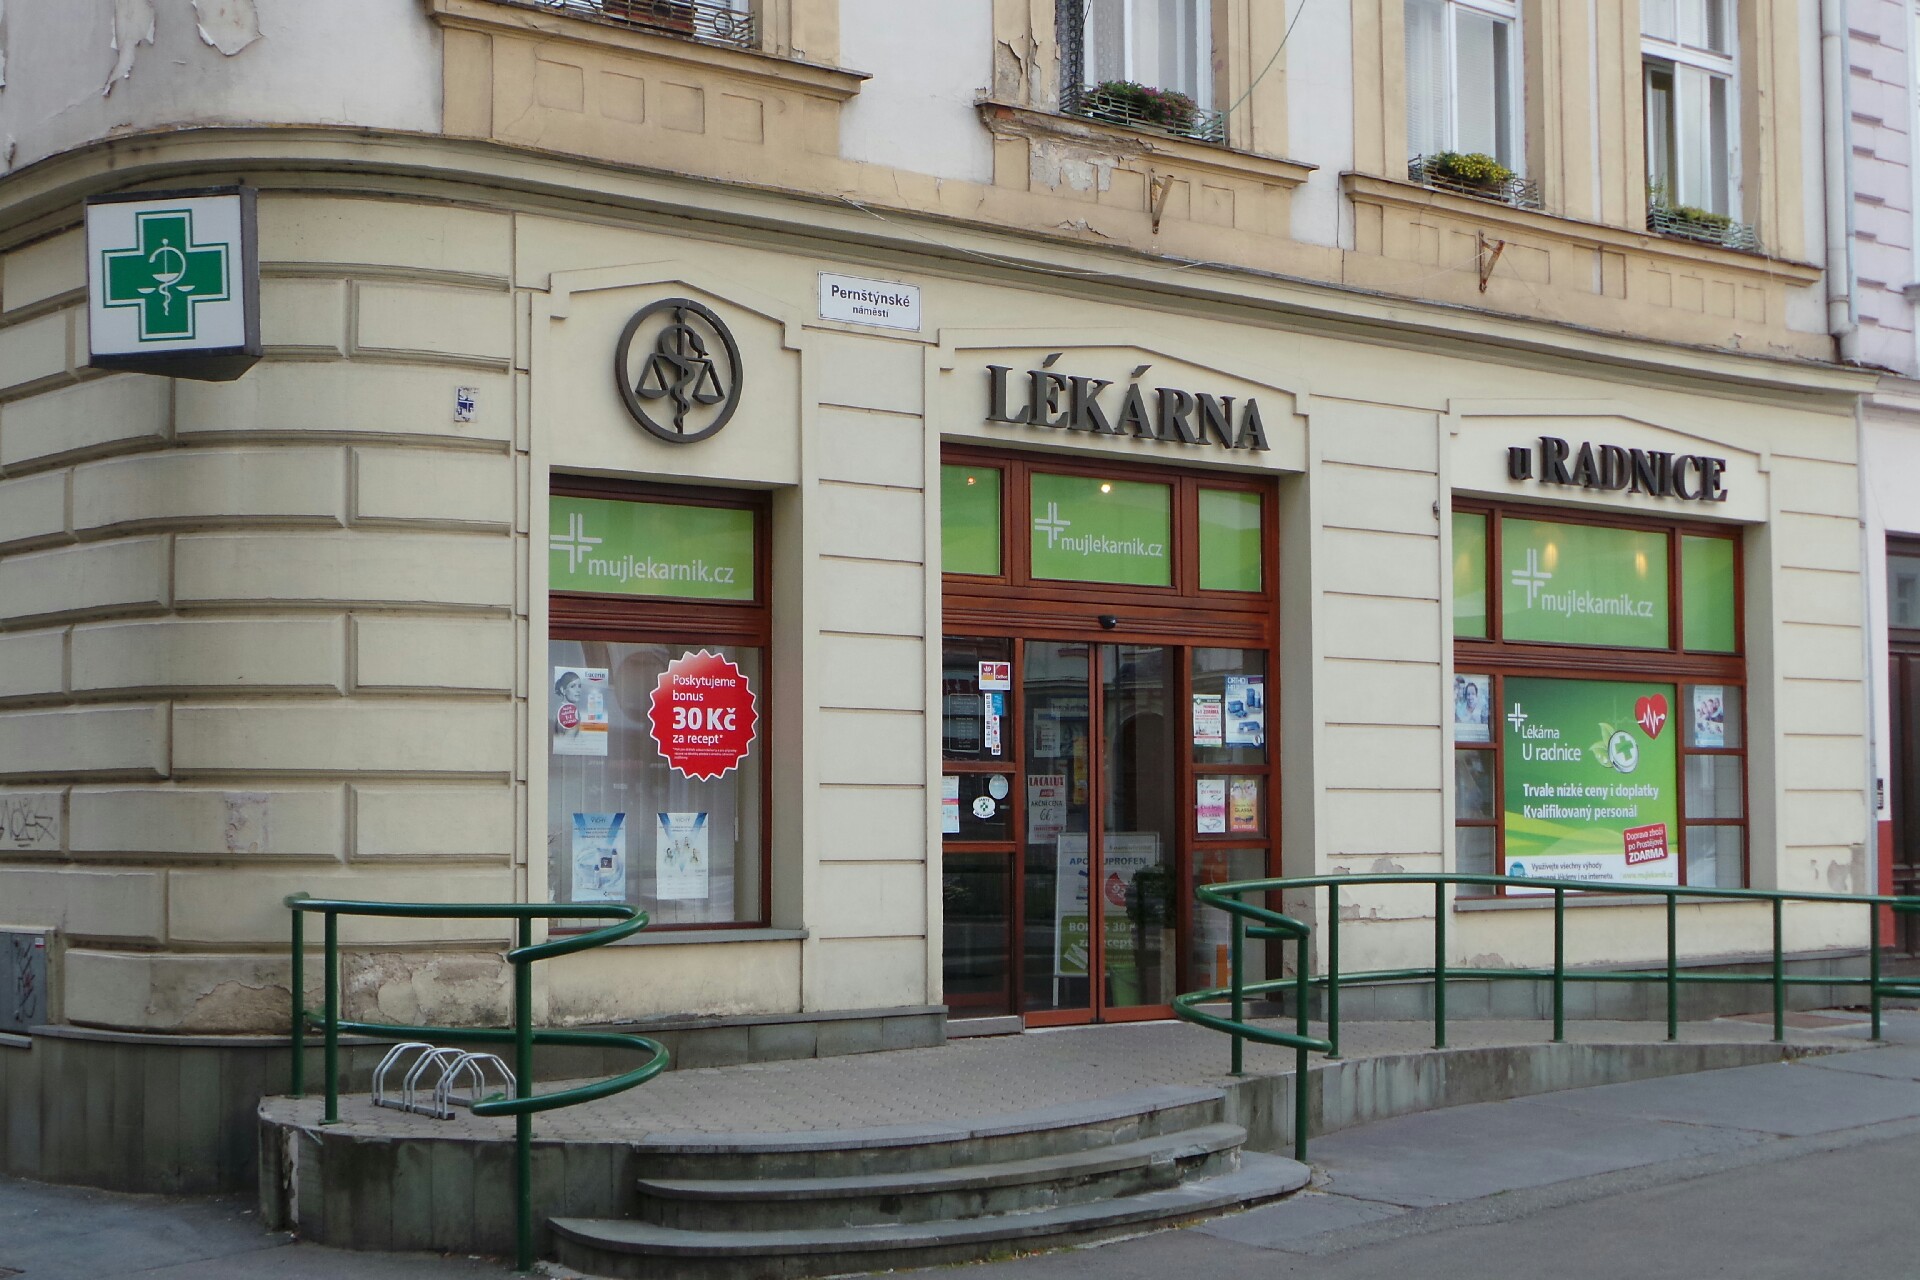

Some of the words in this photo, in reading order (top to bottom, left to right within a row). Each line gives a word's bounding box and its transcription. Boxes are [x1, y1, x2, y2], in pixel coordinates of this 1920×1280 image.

[831, 284, 910, 307] Pernštýnské
[852, 305, 889, 318] náměstí
[985, 352, 1271, 451] LÉKÁRNA
[1508, 446, 1534, 480] u
[1538, 436, 1728, 502] RADNICE
[1061, 534, 1163, 557] mujlekarnik.cz
[588, 553, 734, 584] mujlekarnik.cz
[1541, 590, 1653, 618] mujlekarnik.cz
[673, 674, 736, 688] Poskytujeme
[672, 689, 704, 701] bonus
[672, 706, 702, 730] 30
[706, 707, 736, 731] Kč
[672, 735, 684, 743] za
[1522, 725, 1560, 739] Lékárna
[1522, 743, 1533, 761] U
[1536, 743, 1581, 761] radnice
[1523, 783, 1554, 797] Trvale
[1557, 783, 1583, 797] nízké
[1585, 786, 1608, 800] ceny
[1610, 784, 1614, 797] i
[1616, 784, 1659, 800] doplatky
[1523, 804, 1591, 821] Kvalifikovaný
[1594, 805, 1637, 820] personál
[1626, 831, 1649, 842] Doprava
[1628, 843, 1636, 852] po
[1628, 847, 1665, 863] ZDARMA
[1560, 861, 1581, 871] všechny
[1582, 860, 1602, 871] výhody
